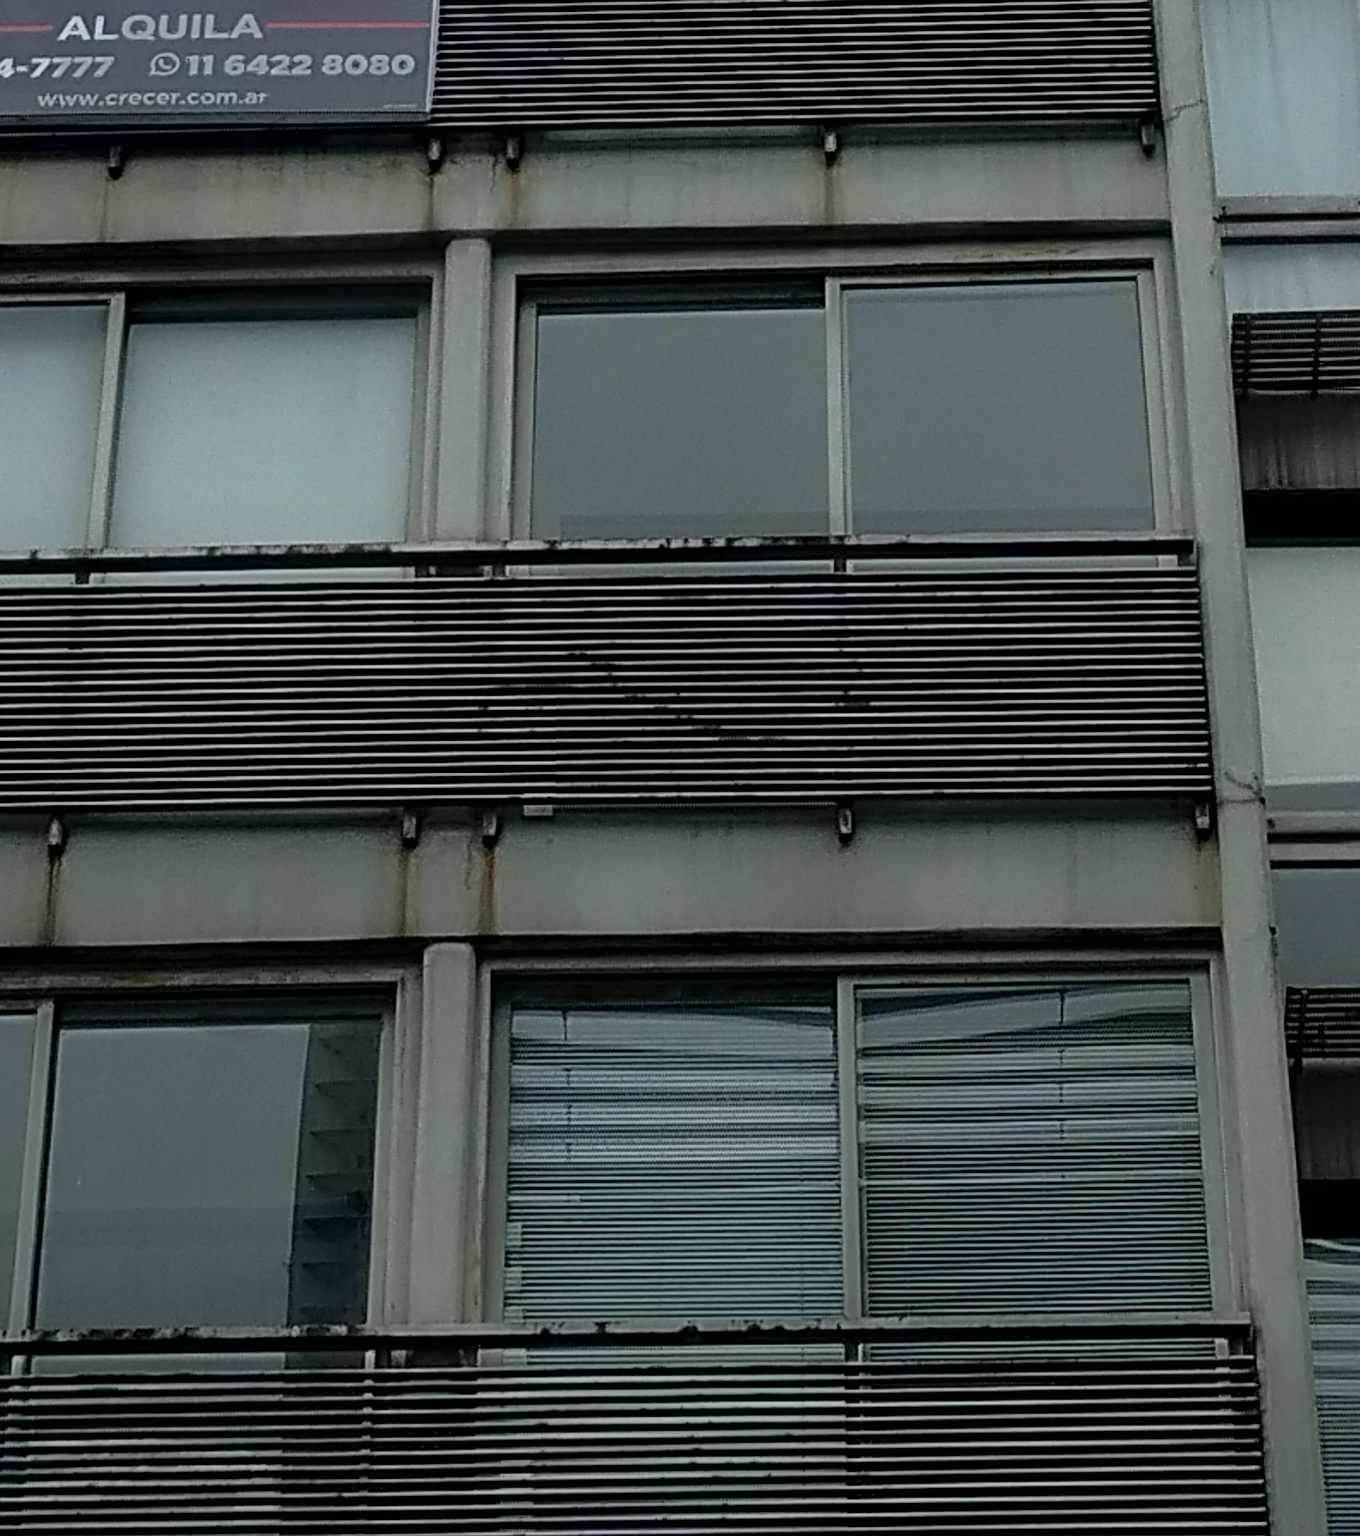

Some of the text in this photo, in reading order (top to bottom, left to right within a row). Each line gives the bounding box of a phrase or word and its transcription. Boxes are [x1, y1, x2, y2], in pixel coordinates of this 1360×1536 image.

[56, 13, 264, 42] ALQUILA
[186, 54, 214, 77] 11
[224, 53, 313, 77] 6422
[321, 52, 417, 77] 8080
[37, 90, 270, 109] www.crecer.com.ar
